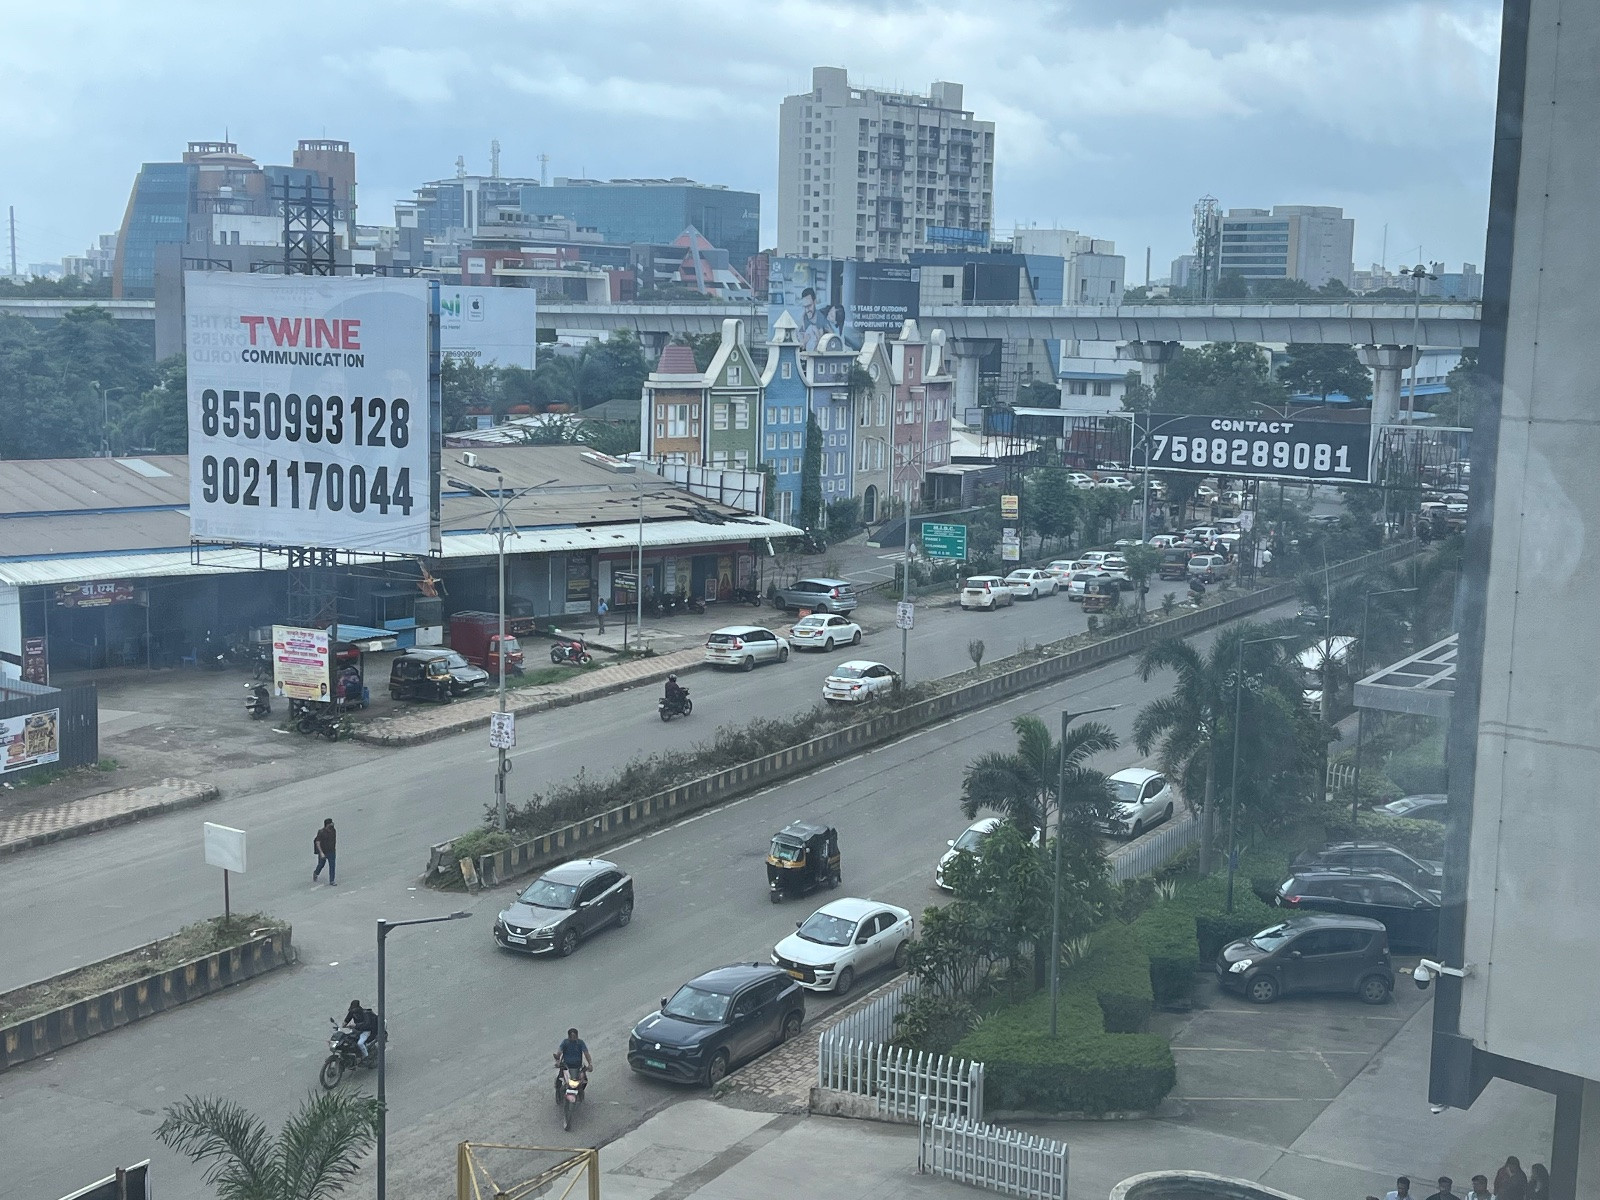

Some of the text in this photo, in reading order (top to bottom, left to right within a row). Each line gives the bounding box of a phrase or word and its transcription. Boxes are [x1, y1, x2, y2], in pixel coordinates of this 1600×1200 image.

[240, 315, 362, 351] TWINE
[201, 389, 411, 449] 8550993128
[1211, 418, 1294, 434] CONTACT
[1152, 435, 1352, 473] 7588289081
[202, 455, 414, 517] 9021170044
